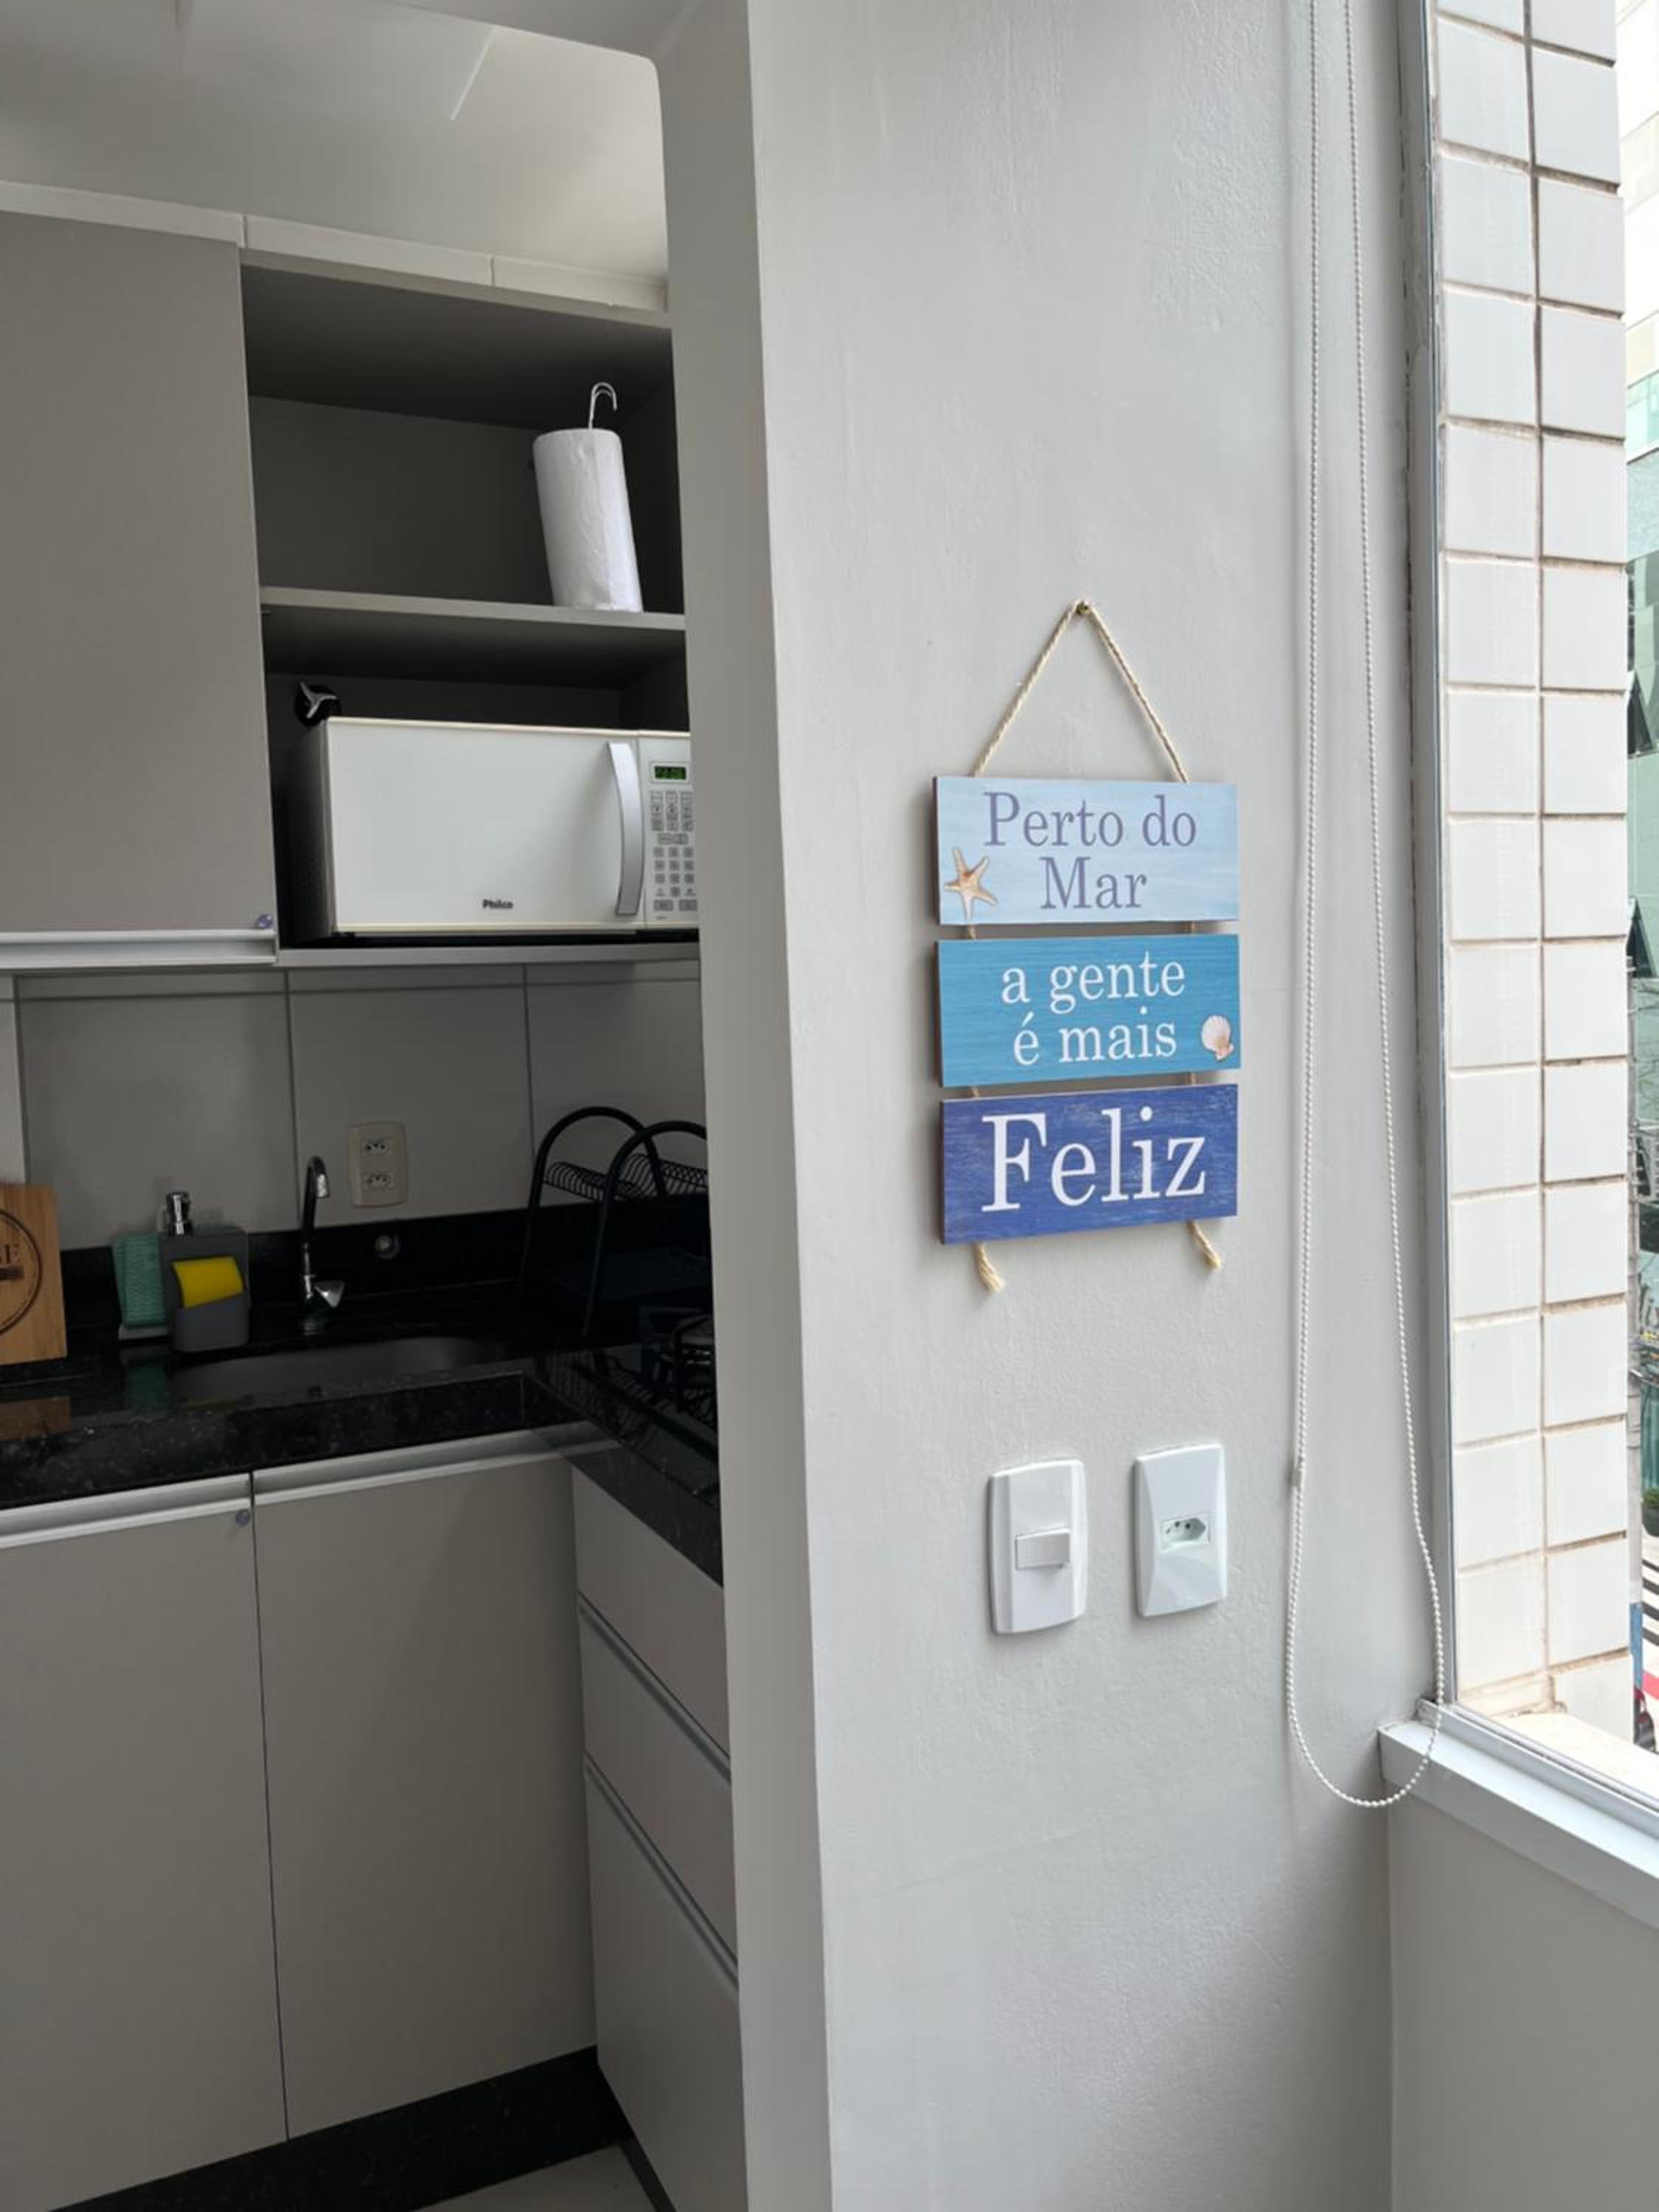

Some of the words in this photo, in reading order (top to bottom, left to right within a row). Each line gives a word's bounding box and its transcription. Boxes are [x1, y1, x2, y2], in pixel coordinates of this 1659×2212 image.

[983, 791, 1124, 847] Perto
[1142, 794, 1197, 847] do
[482, 899, 514, 908] Philco
[1040, 856, 1147, 909] Mar
[1001, 967, 1030, 1004] a
[1049, 951, 1185, 1015] gente
[1013, 1012, 1040, 1065] é
[1059, 1006, 1177, 1063] mais
[981, 1106, 1206, 1212] Feliz
